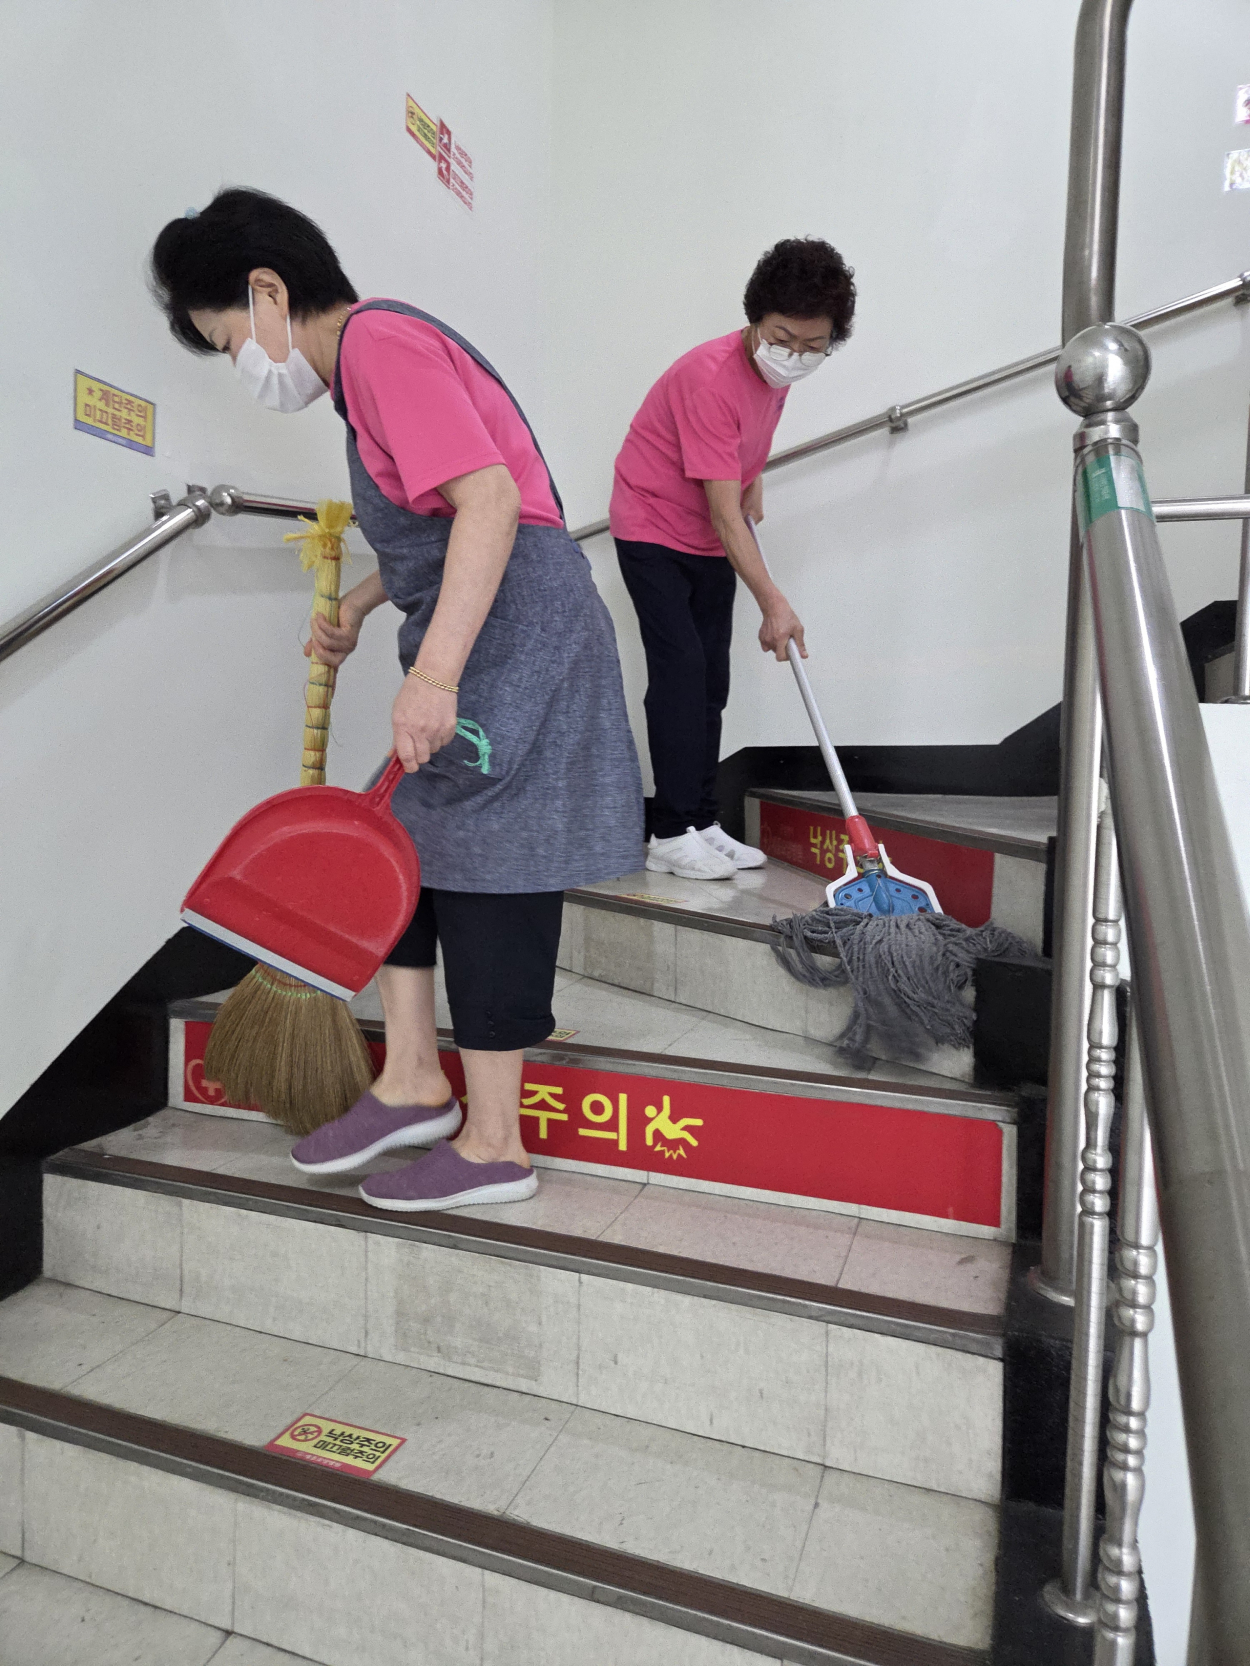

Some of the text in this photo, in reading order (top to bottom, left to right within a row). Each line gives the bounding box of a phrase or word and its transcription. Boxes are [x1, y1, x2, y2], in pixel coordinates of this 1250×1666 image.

[84, 402, 146, 442] 미끄럼주의
[98, 387, 148, 423] 계단주의
[809, 826, 883, 876] 낙상주
[460, 1083, 628, 1151] 주의
[313, 1439, 381, 1465] 미끄럼주의
[324, 1428, 393, 1454] 낙상주의
